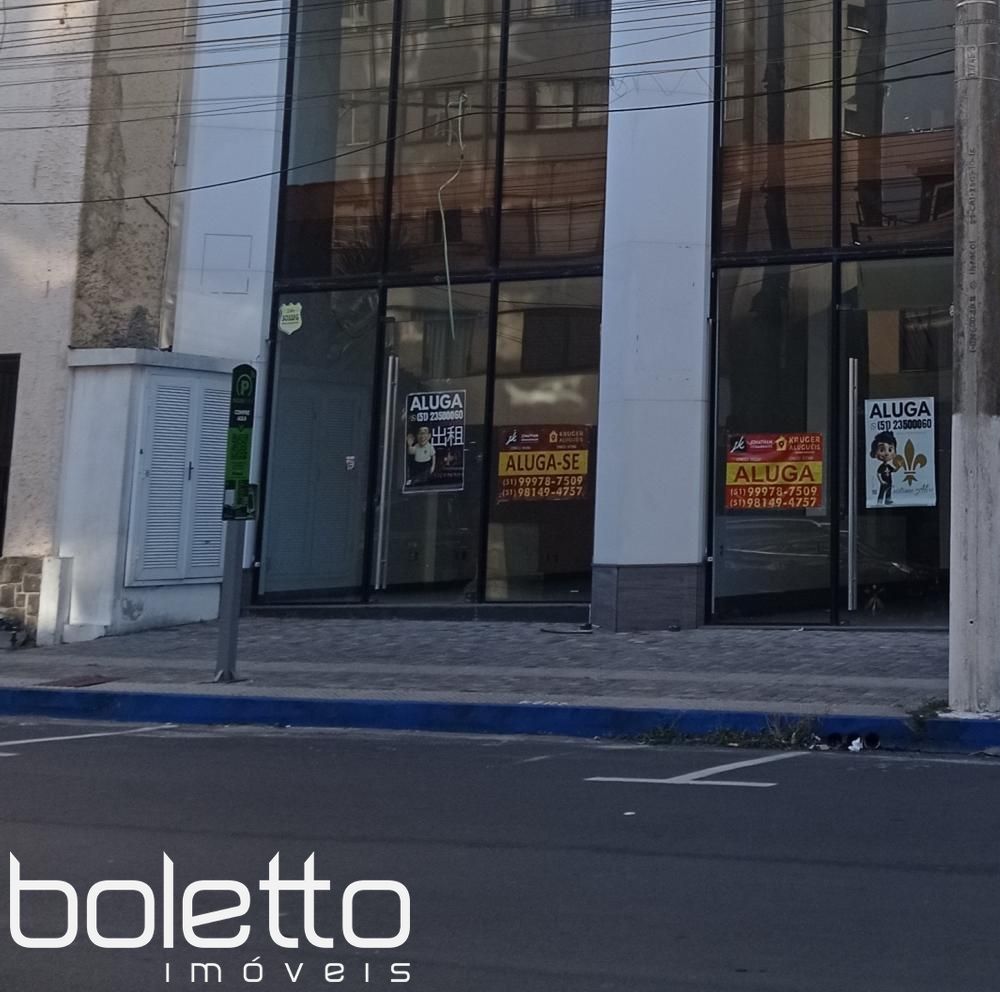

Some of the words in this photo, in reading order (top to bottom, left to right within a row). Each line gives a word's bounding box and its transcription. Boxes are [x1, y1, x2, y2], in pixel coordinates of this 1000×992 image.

[410, 393, 463, 411] ALUGA
[870, 401, 931, 419] ALUGA
[877, 420, 891, 431] (51)
[893, 418, 932, 430] 23500060
[431, 425, 464, 447] 出租
[505, 453, 580, 472] ALUGA-SE
[518, 476, 583, 486] 99978-7509
[734, 464, 815, 483] ALUGA
[518, 487, 583, 497] 98149-4757
[730, 488, 746, 497] (51)
[747, 487, 817, 497] 99978-7509
[730, 498, 746, 507] (51)
[747, 497, 817, 508] 98149-4757
